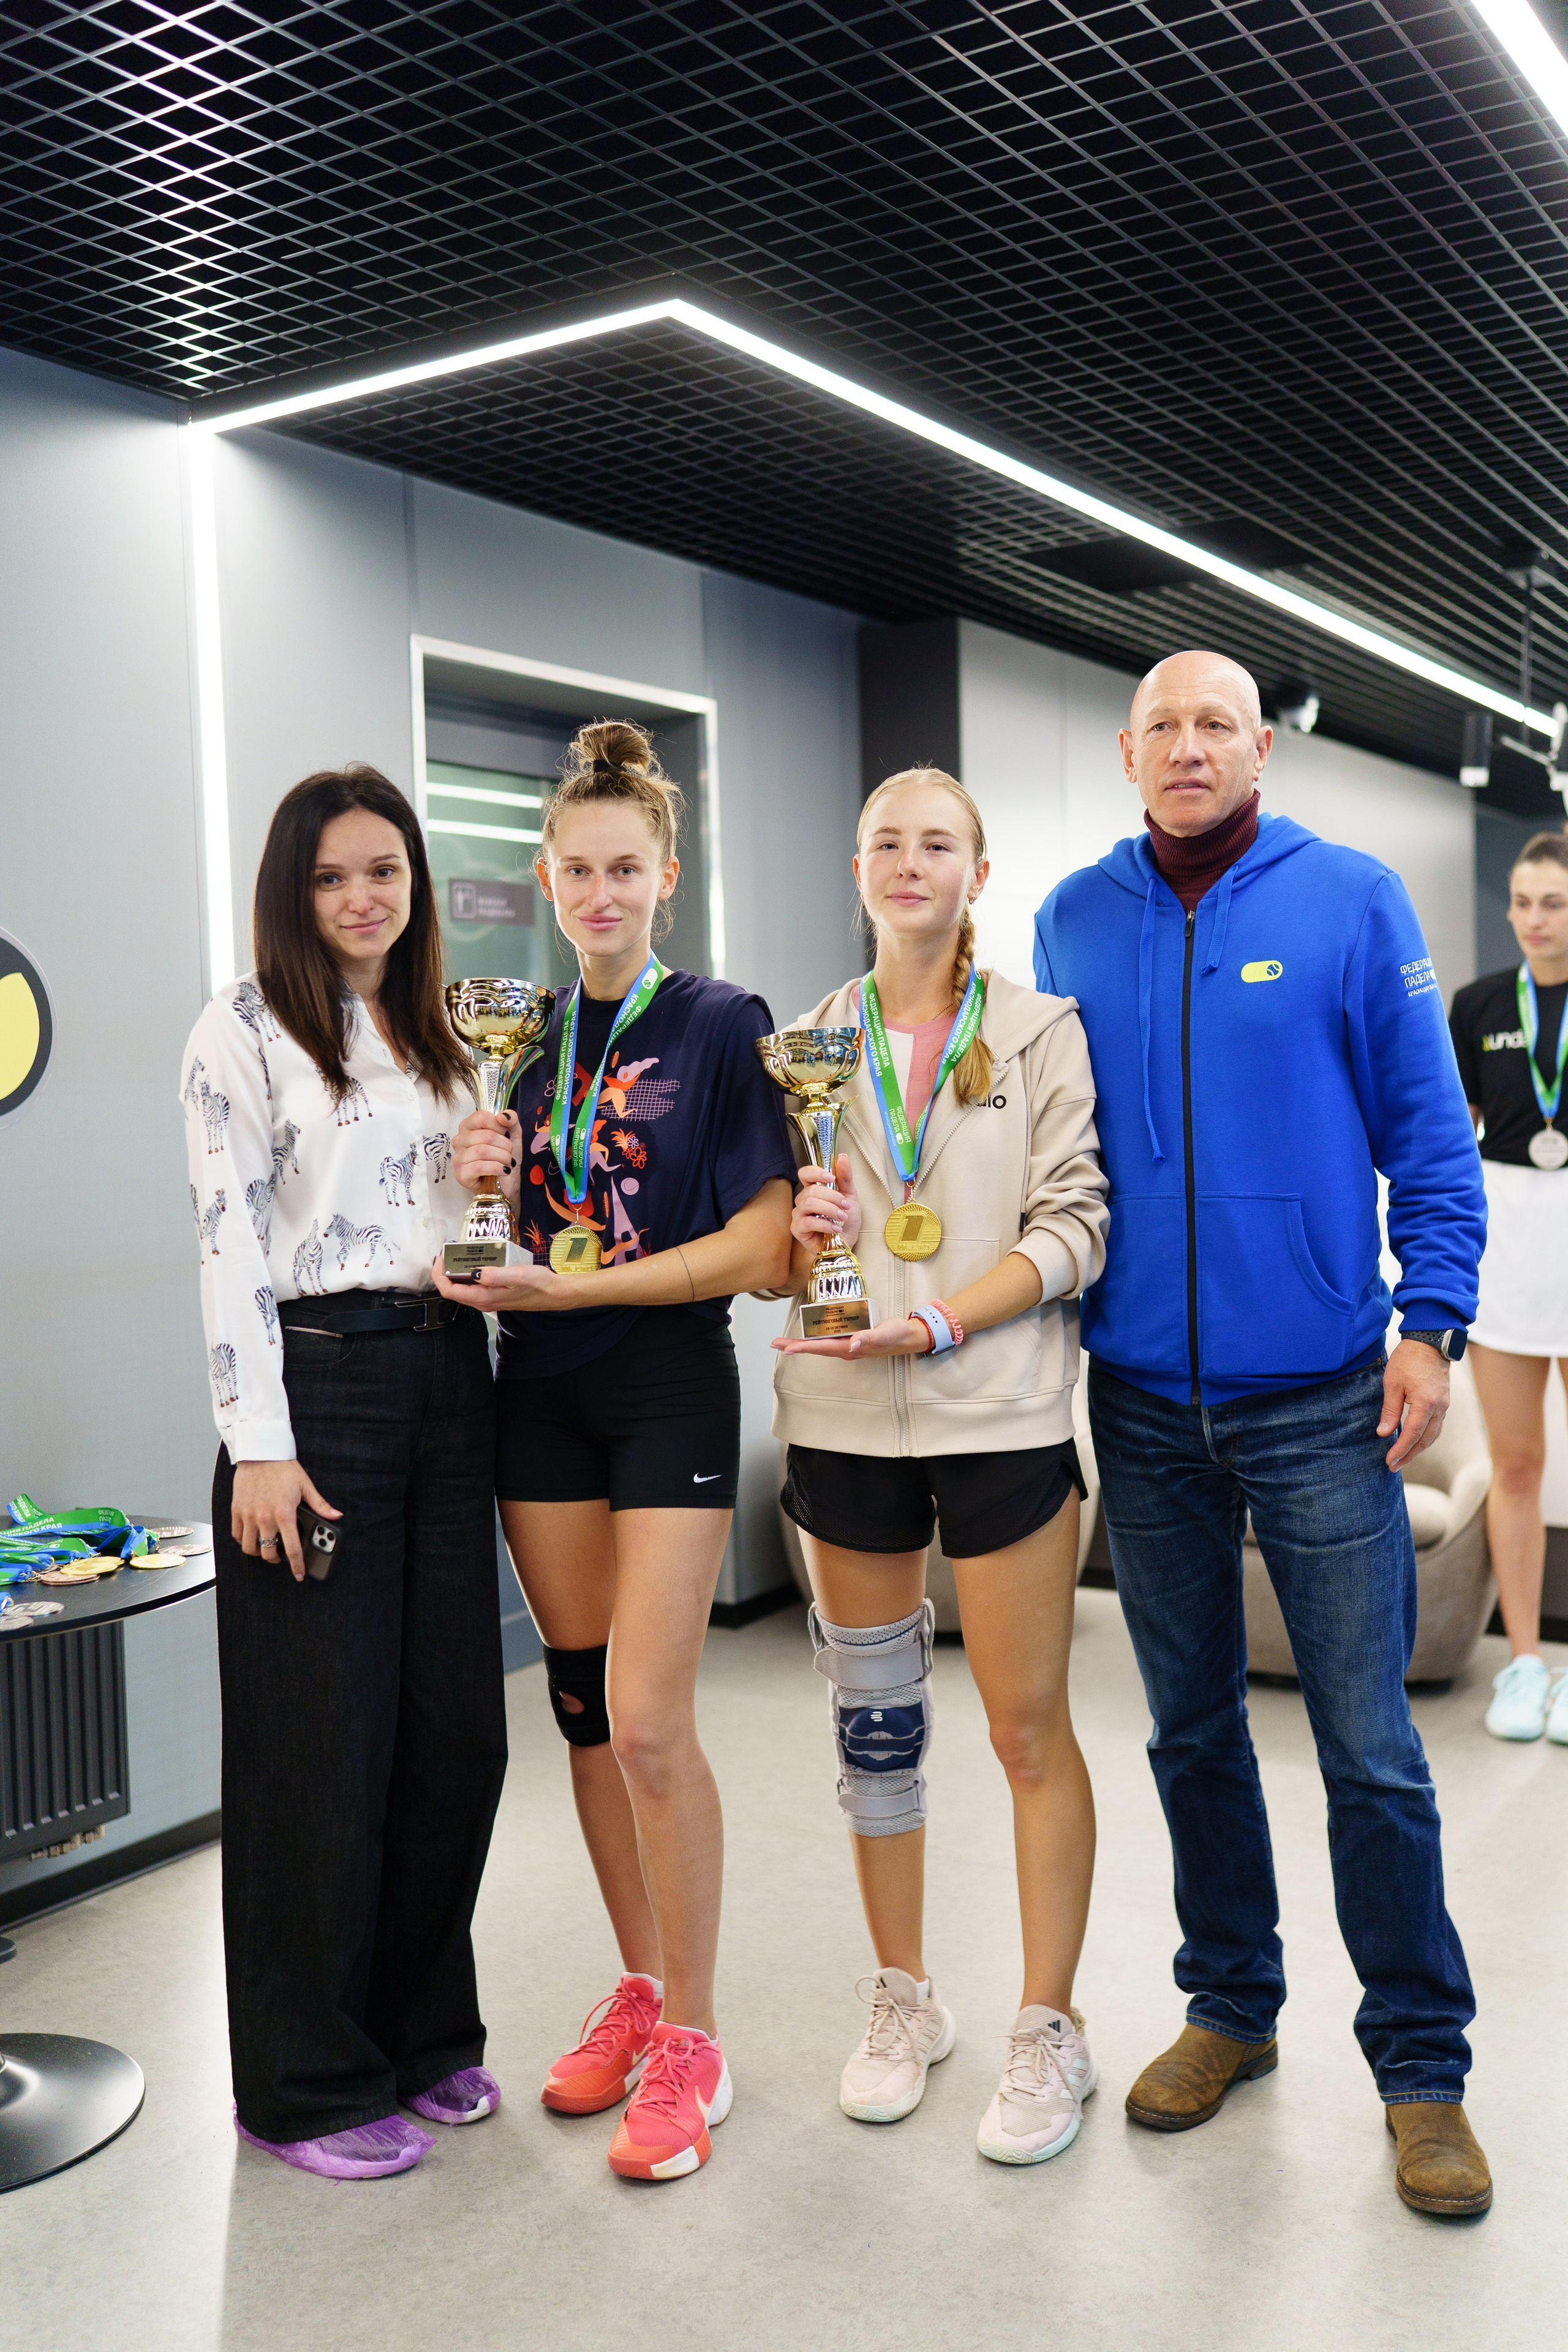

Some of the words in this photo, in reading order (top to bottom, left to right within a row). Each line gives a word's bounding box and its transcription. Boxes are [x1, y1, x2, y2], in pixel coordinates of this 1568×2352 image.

[1404, 970, 1431, 988] ПАДЕЛА
[608, 1005, 642, 1047] ФЕДЕРАЦИ
[611, 993, 639, 1034] КРАСНОД
[869, 992, 883, 1036] ФЕДЕРАЦИЯ
[877, 1036, 891, 1068] ПАДЕЛА
[952, 981, 976, 1043] КРАСНОДАРСКОГО
[967, 993, 982, 1032] ФЕДЕРАЦИЯ
[861, 992, 878, 1057] КРАСНОДАРСКОГО
[872, 1057, 883, 1078] КРАЯ
[942, 1042, 956, 1065] КРАЯ
[951, 1031, 971, 1063] ПАДЕЛА
[556, 1052, 565, 1101] ФЕДЕРАЦИЯ
[561, 1019, 570, 1052] ПАДЕЛА
[562, 1031, 575, 1106] КРАСНОДАРСКОГО
[889, 1108, 900, 1133] ПАДЕЛА
[897, 1106, 911, 1143] ФЕДЕРАЦИЯ
[899, 1215, 924, 1242] 1
[565, 1237, 589, 1263] 1
[22, 1517, 55, 1531] ПАДЕЛА
[41, 1523, 62, 1531] КРАЯ
